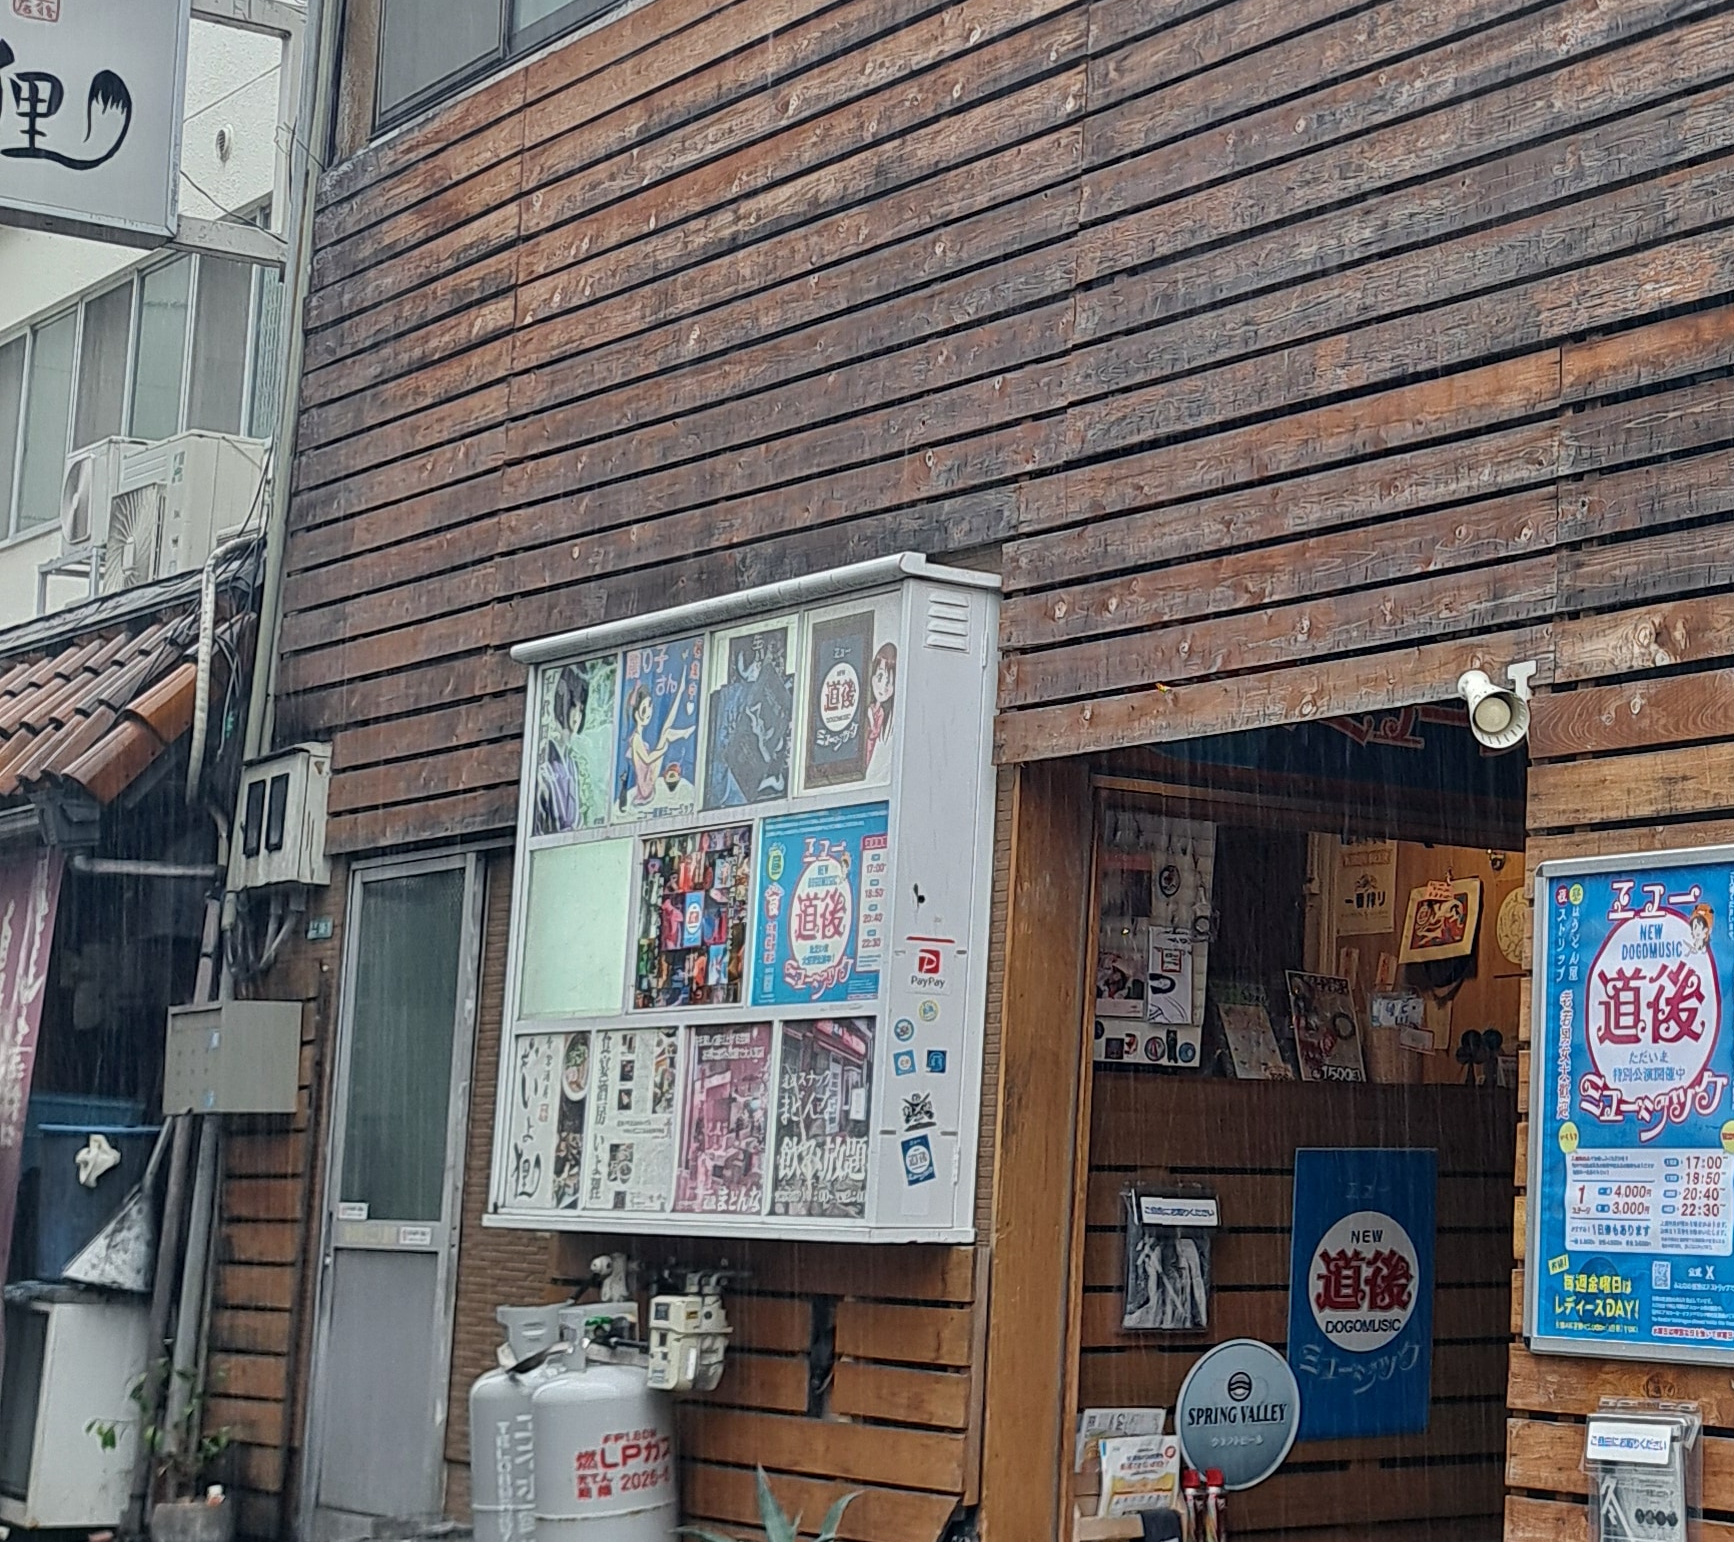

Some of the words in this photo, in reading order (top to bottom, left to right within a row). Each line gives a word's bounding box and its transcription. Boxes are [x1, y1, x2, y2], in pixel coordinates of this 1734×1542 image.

[823, 680, 857, 712] 道後
[803, 836, 848, 863] ニュー
[1607, 879, 1702, 921] ニュー
[794, 886, 847, 943] 道後
[1640, 923, 1664, 942] NEW
[1621, 940, 1683, 960] DOGOMUSIC
[910, 975, 946, 989] PayPay
[1598, 960, 1706, 1046] 道後
[1579, 1068, 1730, 1144] ミュージック
[778, 1135, 868, 1182] 飲み放題
[1351, 1230, 1384, 1244] NEW
[1315, 1247, 1414, 1314] 道後
[1563, 1272, 1633, 1295] 毎週金曜日は
[1555, 1295, 1640, 1320] レディースDAY!
[1325, 1318, 1401, 1335] DOGOMUSIC
[1300, 1341, 1421, 1396] ミュージック
[1188, 1406, 1237, 1427] SPRING
[1241, 1402, 1288, 1425] VALLEY
